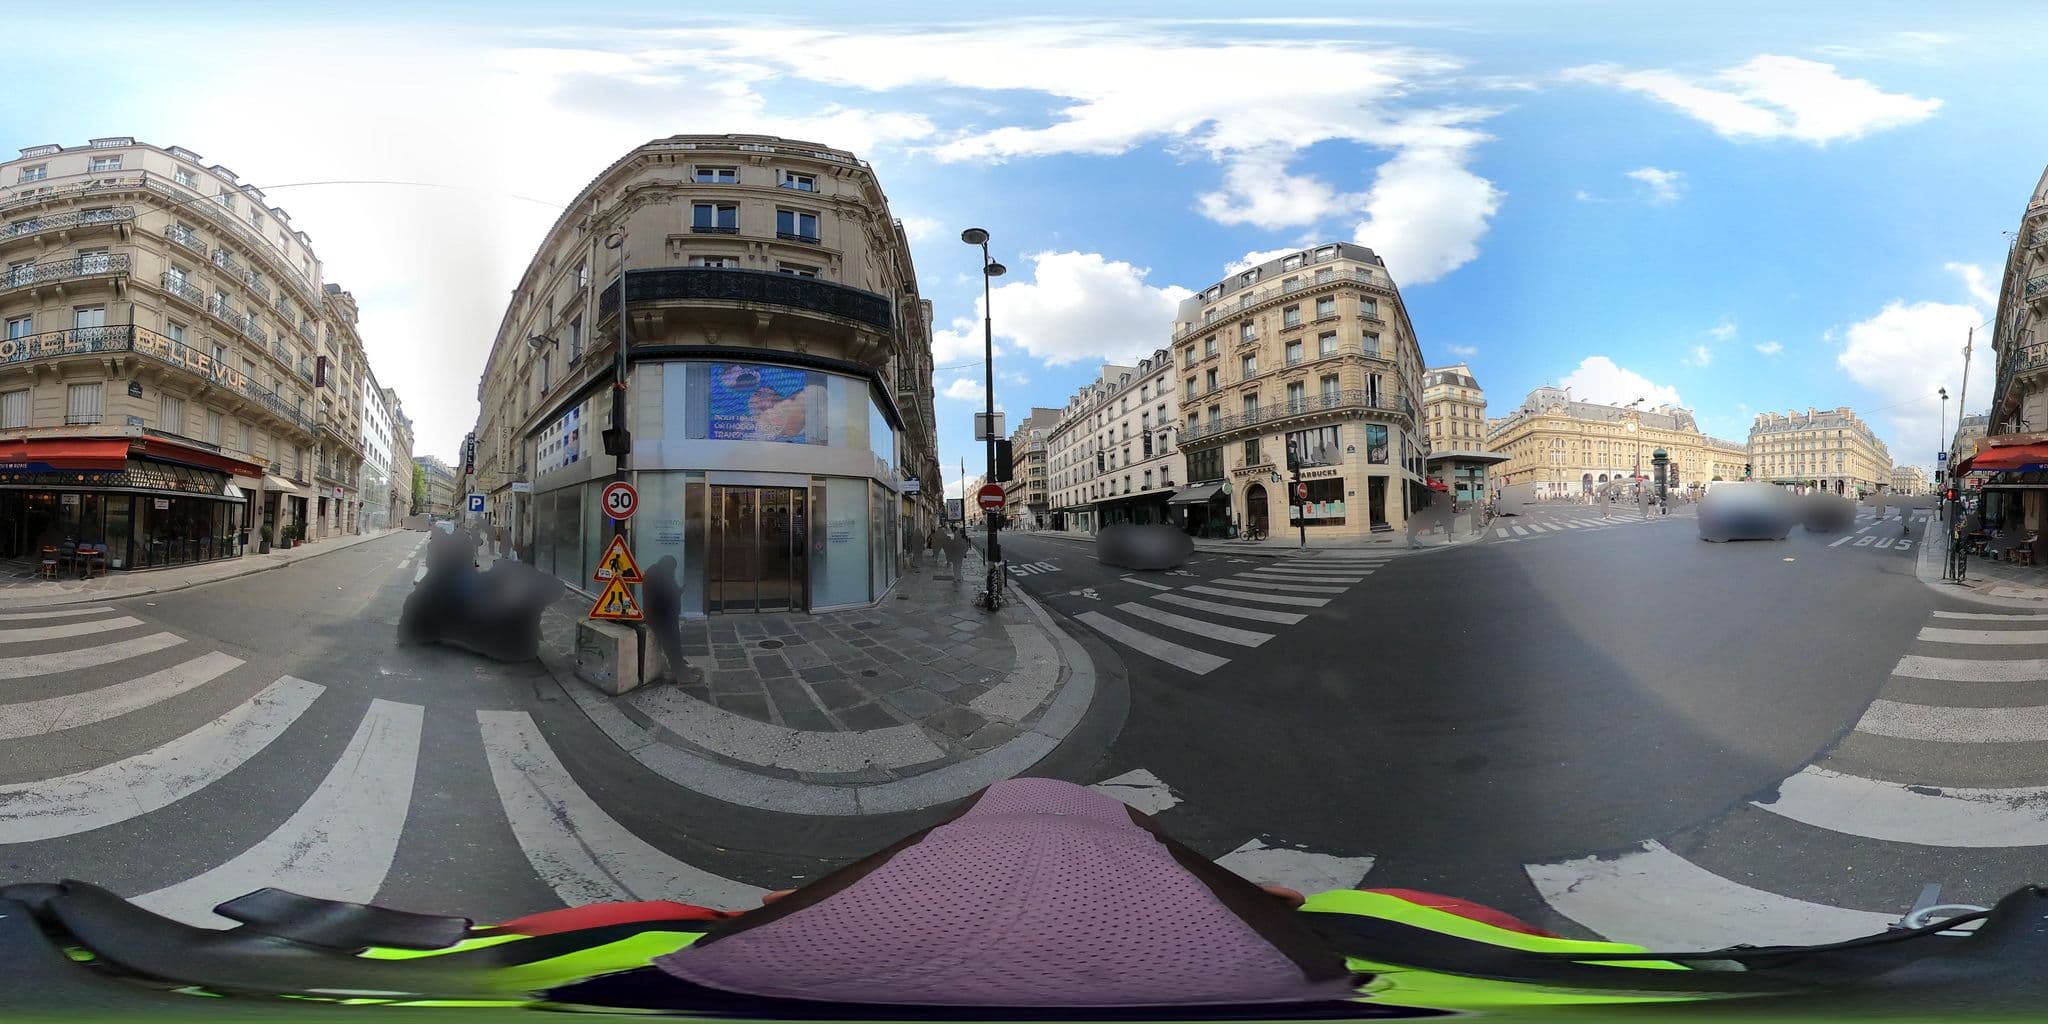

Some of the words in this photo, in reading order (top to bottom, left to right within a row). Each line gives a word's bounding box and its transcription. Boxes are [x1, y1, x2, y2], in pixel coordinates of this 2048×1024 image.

[136, 326, 247, 389] BELLEVUE
[1296, 469, 1337, 478] ARBUCKS
[471, 498, 482, 510] P
[610, 492, 632, 508] 30
[1852, 535, 1913, 550] BUS
[1007, 561, 1062, 576] BUS
